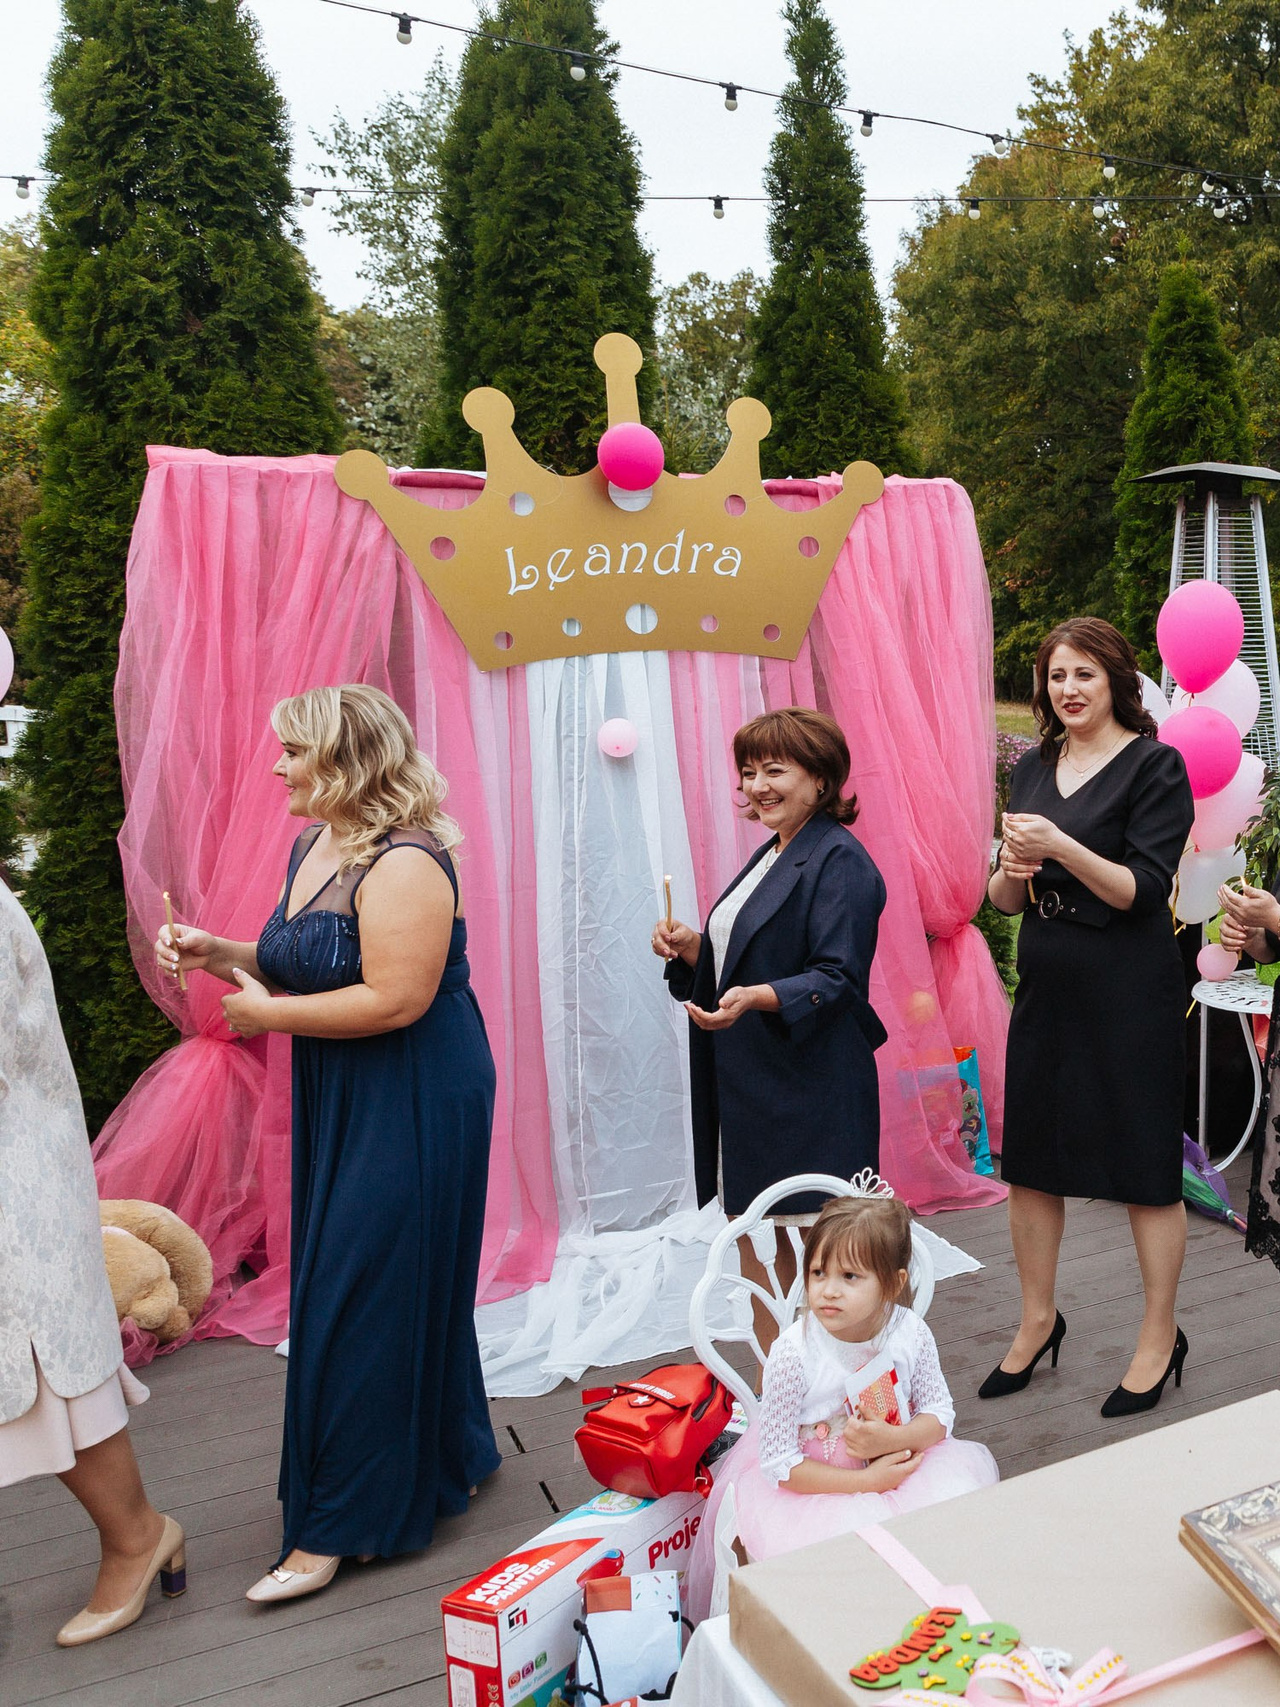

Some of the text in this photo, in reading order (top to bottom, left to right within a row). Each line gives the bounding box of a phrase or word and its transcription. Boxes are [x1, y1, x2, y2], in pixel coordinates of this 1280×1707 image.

[504, 527, 742, 596] Leandra
[466, 1562, 530, 1602] KIDS
[484, 1558, 556, 1606] PAINTER
[849, 1606, 962, 1682] LEANDRA
